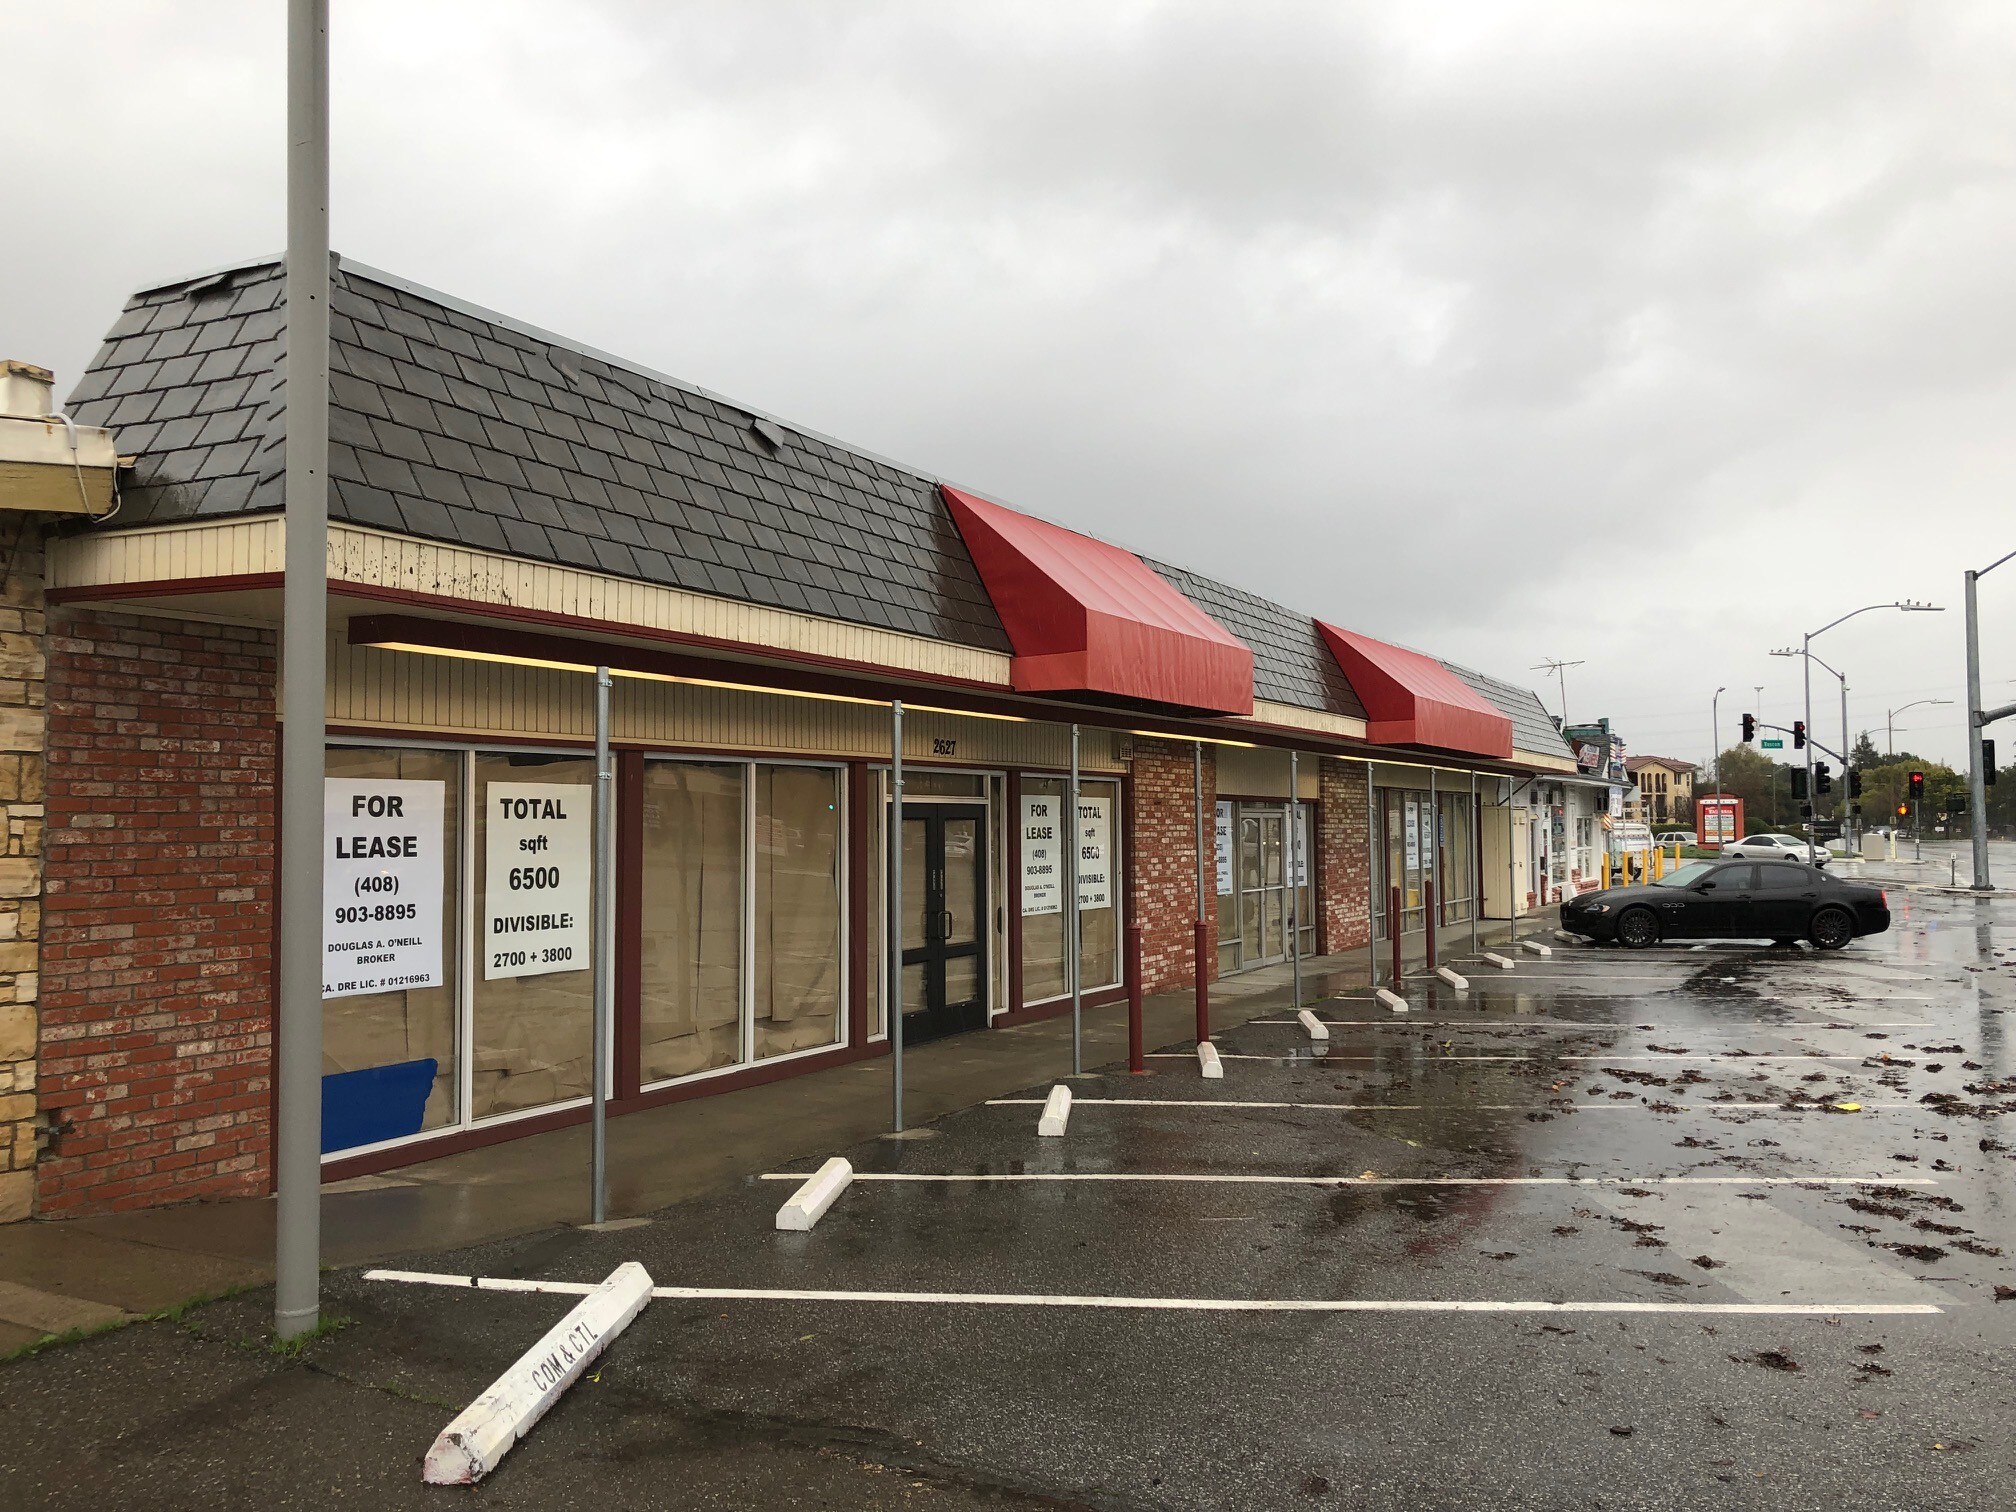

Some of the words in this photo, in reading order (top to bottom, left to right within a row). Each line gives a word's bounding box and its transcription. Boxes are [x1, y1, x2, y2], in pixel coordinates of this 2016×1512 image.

[933, 738, 956, 756] 2627
[352, 795, 404, 818] FOR
[500, 798, 567, 820] TOTAL
[1030, 804, 1048, 817] FOR
[1078, 806, 1102, 819] TOTAL
[1026, 826, 1053, 840] LEASE
[1085, 827, 1095, 839] sqft
[336, 836, 418, 859] LEASE
[519, 835, 548, 855] sqft
[1032, 849, 1047, 860] (408)
[354, 876, 399, 897] (408)
[509, 867, 560, 891] 6500
[1094, 893, 1105, 903] 3800
[335, 903, 417, 924] 903-8895
[493, 913, 574, 934] DIVISIBLE:
[328, 940, 374, 952] DOUGLAS
[376, 940, 385, 948] A.
[388, 937, 423, 948] O'NEILL
[356, 953, 396, 965] BROKER
[493, 951, 526, 968] 2700
[530, 952, 538, 963] +
[541, 946, 573, 963] 3800
[338, 981, 357, 992] DRE
[360, 979, 378, 989] LIC.
[388, 973, 430, 986] 01216963
[531, 1352, 567, 1392] COM
[560, 1344, 576, 1363] &
